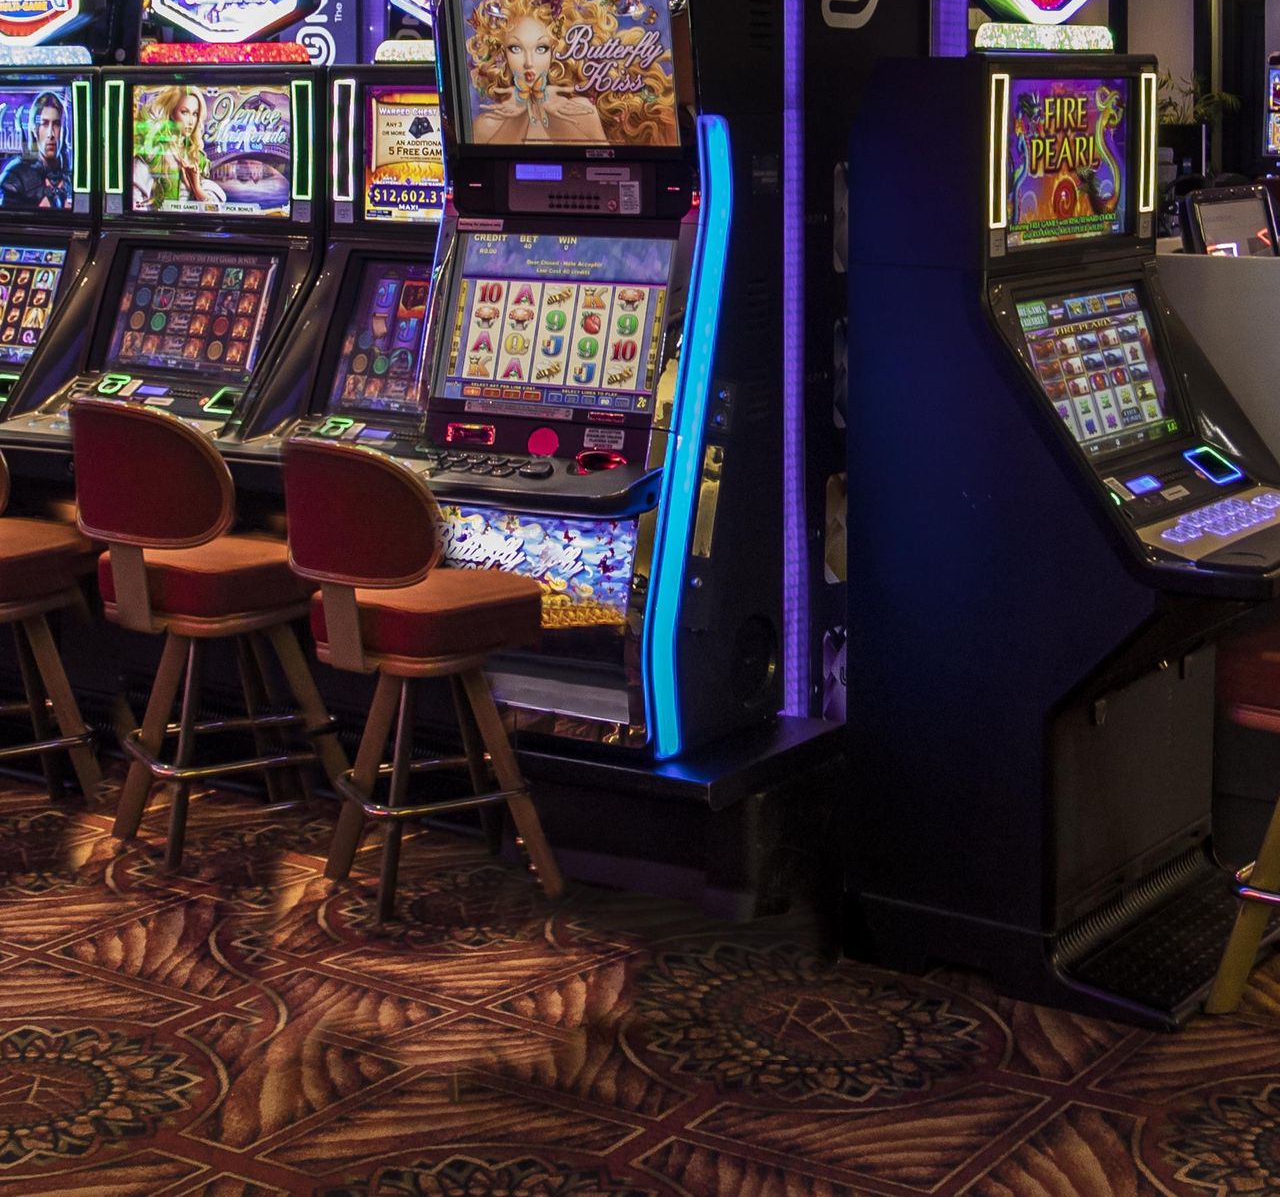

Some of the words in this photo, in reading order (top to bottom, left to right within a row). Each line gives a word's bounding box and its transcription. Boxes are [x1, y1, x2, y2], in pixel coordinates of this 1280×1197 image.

[334, 5, 343, 23] The
[555, 24, 664, 68] Butterfly
[575, 61, 645, 93] Kiss
[212, 91, 282, 125] Venice
[378, 107, 411, 116] WARPED
[412, 107, 437, 116] CHEST
[1044, 97, 1089, 130] FIRE
[388, 147, 395, 156] 5
[396, 147, 420, 156] FREE
[421, 148, 442, 157] GAM
[1030, 135, 1100, 174] PEARL
[474, 234, 508, 242] CREDIT
[520, 235, 538, 243] BET
[558, 236, 578, 245] WIN
[478, 282, 503, 304] 10
[511, 283, 536, 306] A
[581, 287, 609, 310] K
[545, 309, 567, 332] 9
[616, 313, 639, 337] 9
[1055, 325, 1079, 336] FIRE
[471, 331, 493, 353] A
[504, 332, 531, 355] Q
[541, 335, 565, 357] J
[577, 337, 599, 360] 9
[611, 339, 637, 362] 10
[466, 355, 493, 377] K
[500, 357, 524, 380] A
[573, 362, 597, 384] J
